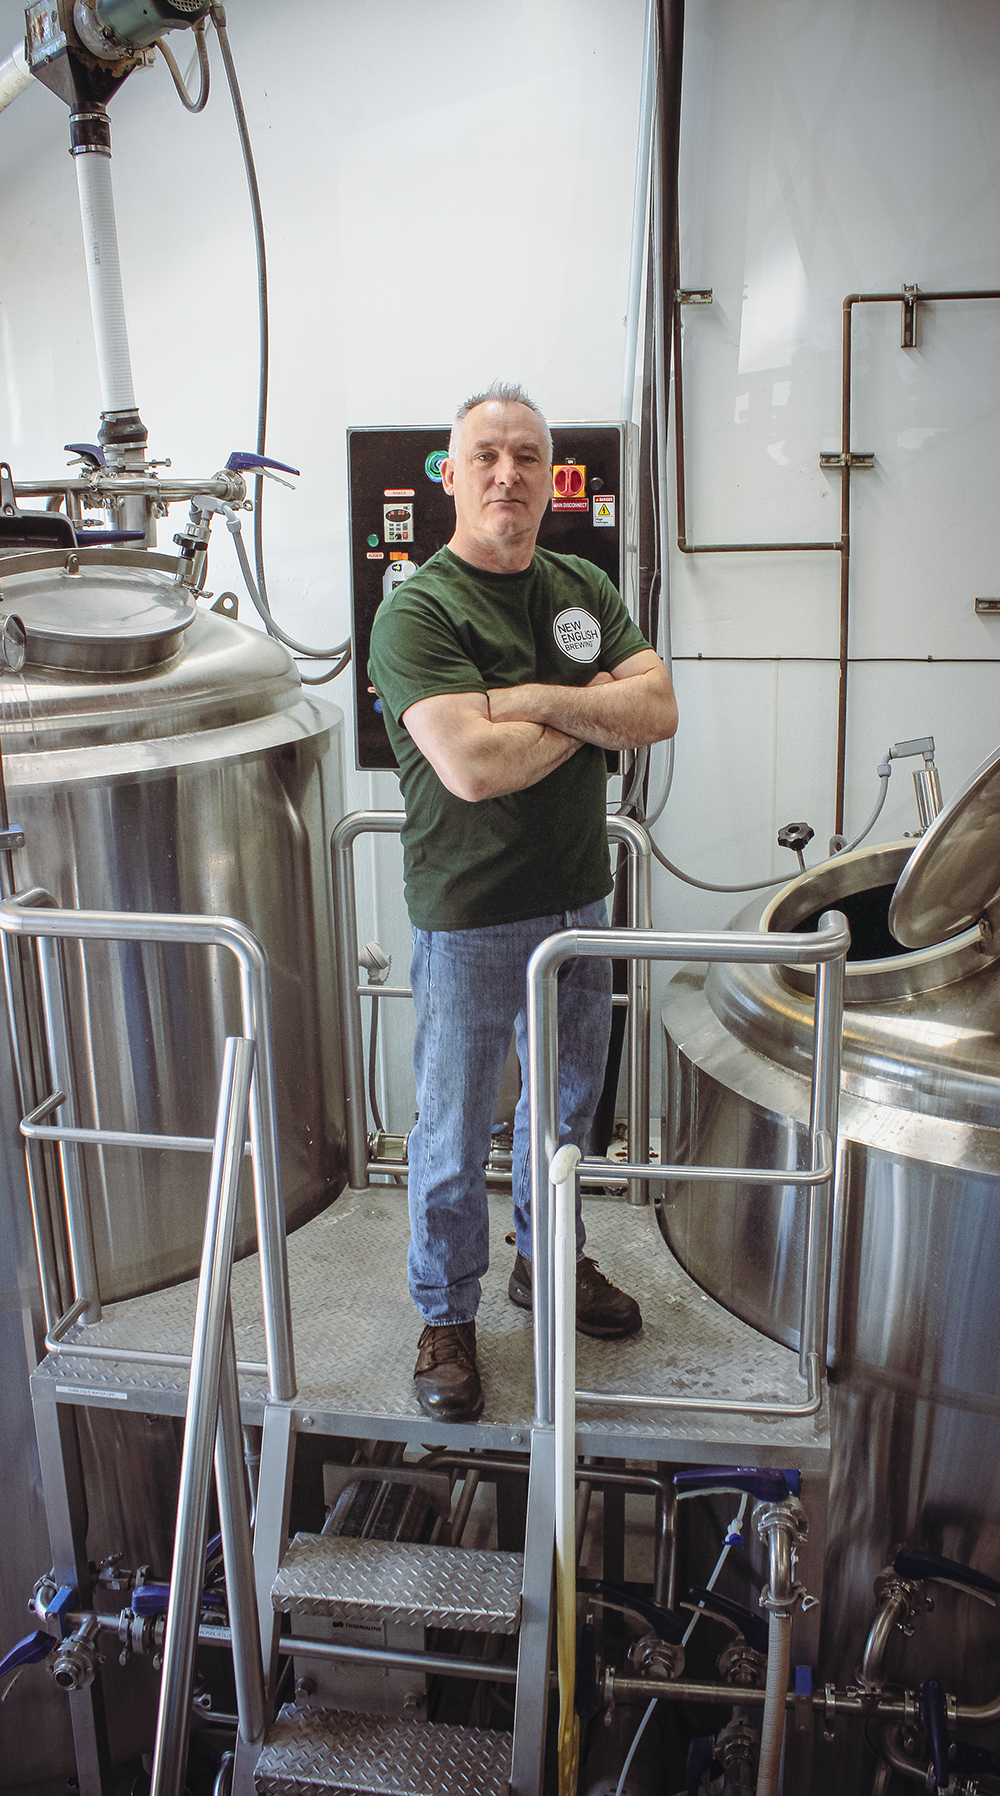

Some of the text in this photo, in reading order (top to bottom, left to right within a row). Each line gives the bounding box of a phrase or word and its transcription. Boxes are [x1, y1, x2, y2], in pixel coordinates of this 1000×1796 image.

[557, 620, 581, 634] NEW
[561, 629, 598, 644] ENGLISH
[565, 640, 593, 651] BREWING
[345, 1622, 381, 1632] THERMALINE
